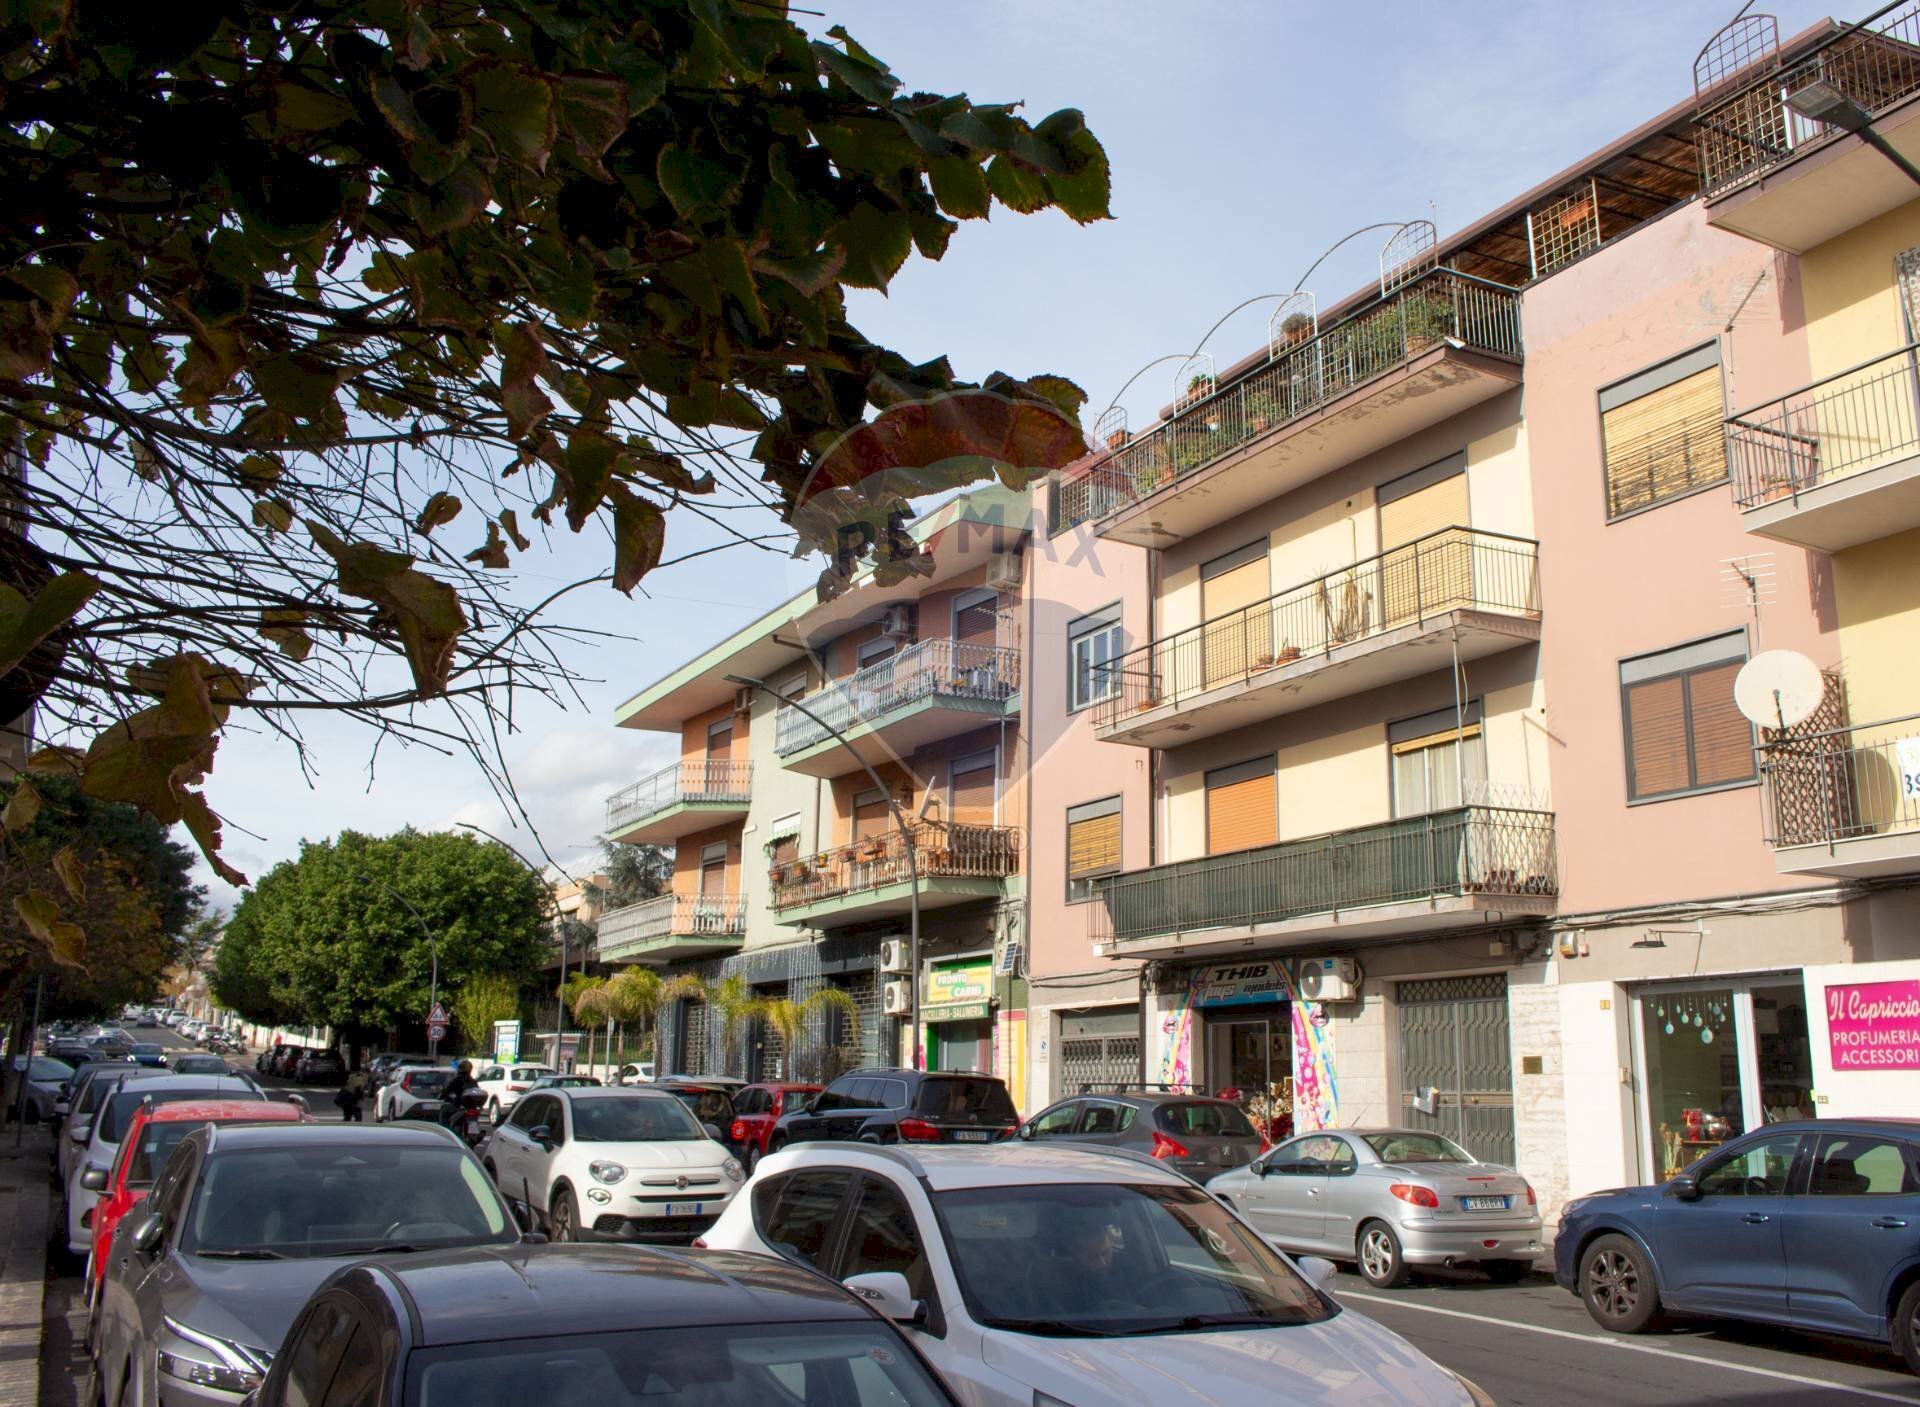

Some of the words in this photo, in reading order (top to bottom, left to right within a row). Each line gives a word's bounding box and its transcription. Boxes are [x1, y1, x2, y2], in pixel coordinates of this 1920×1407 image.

[938, 973, 968, 985] PRONTO
[1215, 964, 1269, 981] THIB
[1830, 990, 1844, 1020] Il
[1848, 990, 1920, 1027] Capriccio
[1833, 1029, 1920, 1046] PROFUMERIA
[1841, 1049, 1918, 1064] ACCESSORI
